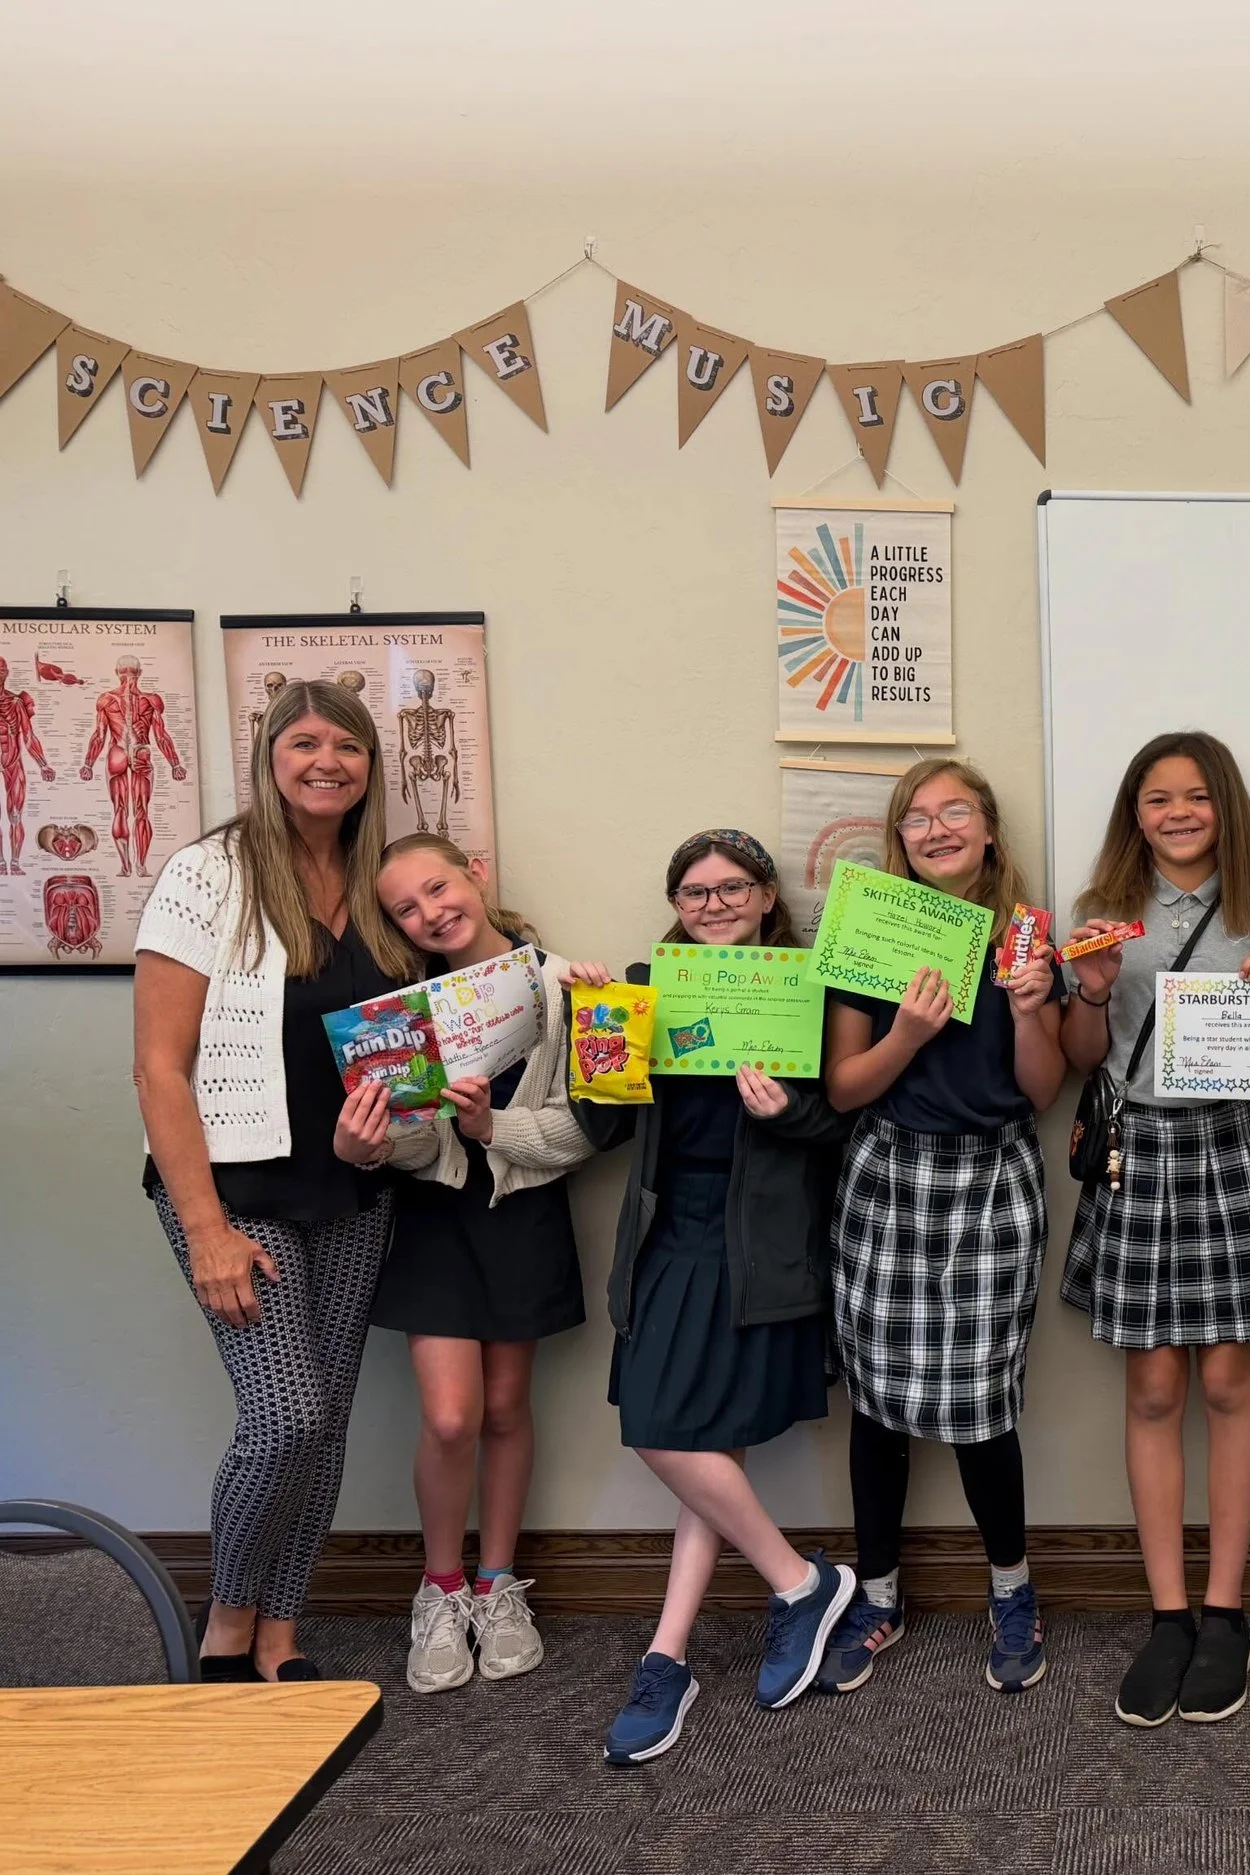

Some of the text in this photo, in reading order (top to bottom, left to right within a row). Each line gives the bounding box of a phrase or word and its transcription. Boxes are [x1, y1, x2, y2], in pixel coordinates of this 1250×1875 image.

[613, 299, 965, 427] MUSIC
[66, 332, 531, 440] SCIENCE
[871, 545, 928, 562] A LITTLE
[871, 566, 944, 582] PROGRESS
[871, 586, 906, 601] EACH
[871, 606, 899, 621] DAY
[3, 623, 157, 635] MUSCULAR SYSTEM
[872, 627, 900, 641] CAN
[262, 634, 443, 647] THE SKELETAL SYSTEM
[872, 646, 922, 661] ADD UP
[872, 666, 915, 681] TO BIG
[872, 686, 930, 702] RESULTS
[863, 887, 963, 927] SKITTLES AWARD
[876, 918, 931, 937] receives this award
[855, 928, 880, 941] Bringing
[882, 935, 895, 943] such
[897, 940, 920, 951] colorful
[921, 948, 936, 956] ideas
[854, 960, 874, 969] signed
[678, 969, 798, 986] Rig Pop Awrd
[1178, 994, 1250, 1005] STARBURST
[1221, 1011, 1242, 1020] Bella
[342, 1027, 426, 1065] Fun Dip
[575, 1035, 626, 1060] Ring
[389, 1063, 410, 1077] Dip
